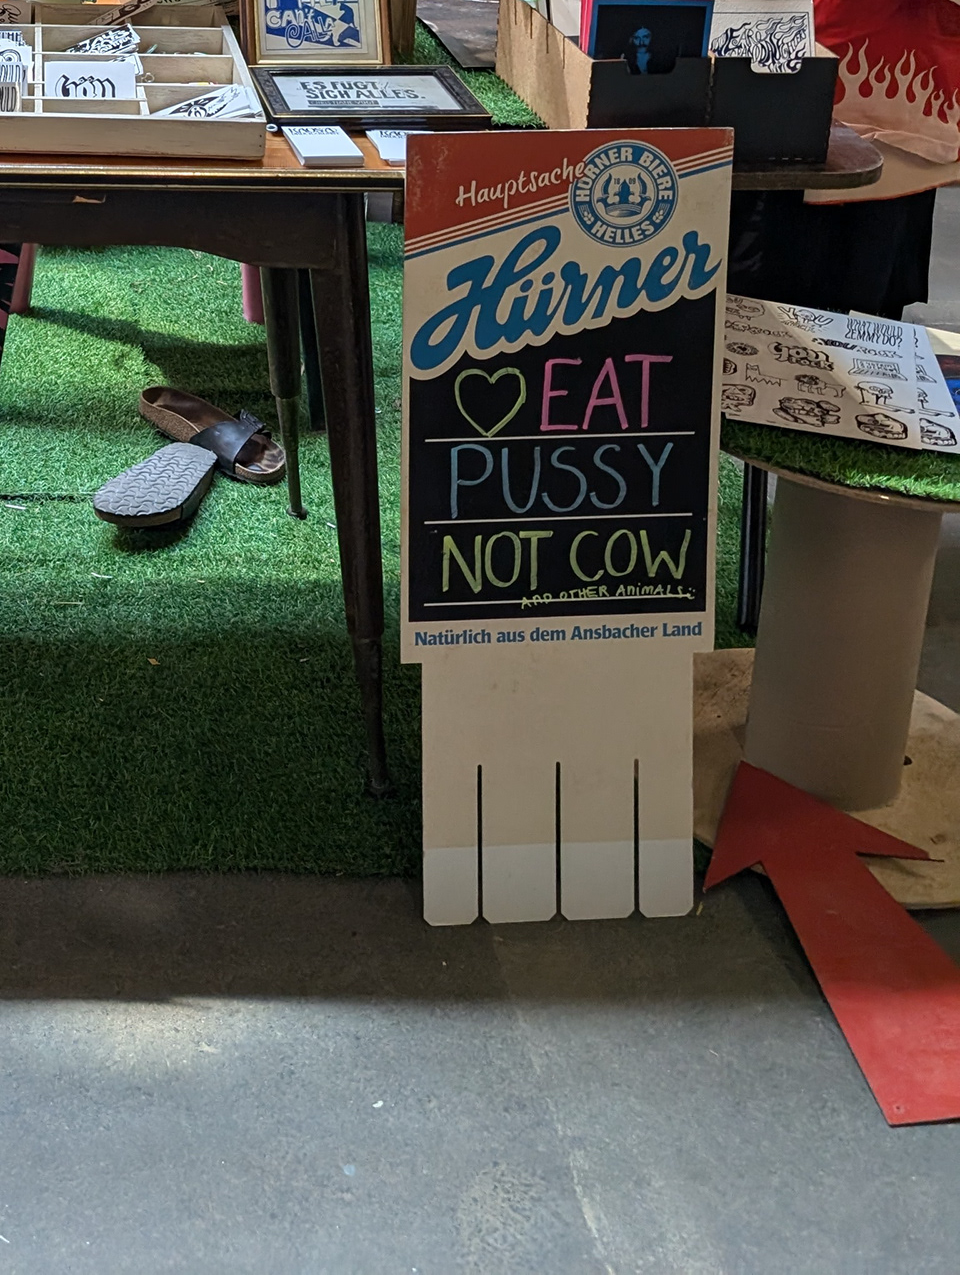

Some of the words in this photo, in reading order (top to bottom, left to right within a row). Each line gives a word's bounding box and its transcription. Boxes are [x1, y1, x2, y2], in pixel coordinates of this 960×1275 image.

[456, 158, 585, 207] Hauptsache
[638, 151, 673, 200] BIERE
[590, 221, 655, 243] HELLES
[410, 225, 721, 371] Hürner
[540, 355, 673, 431] EAT
[450, 442, 674, 519] PUSSY
[442, 530, 554, 594] NOT
[569, 528, 692, 582] COW
[559, 585, 610, 601] OTHER
[414, 629, 491, 647] Natürlich
[496, 631, 525, 644] aus
[529, 627, 566, 642] dem
[570, 624, 658, 641] Ansbacher
[662, 621, 703, 637] Land
